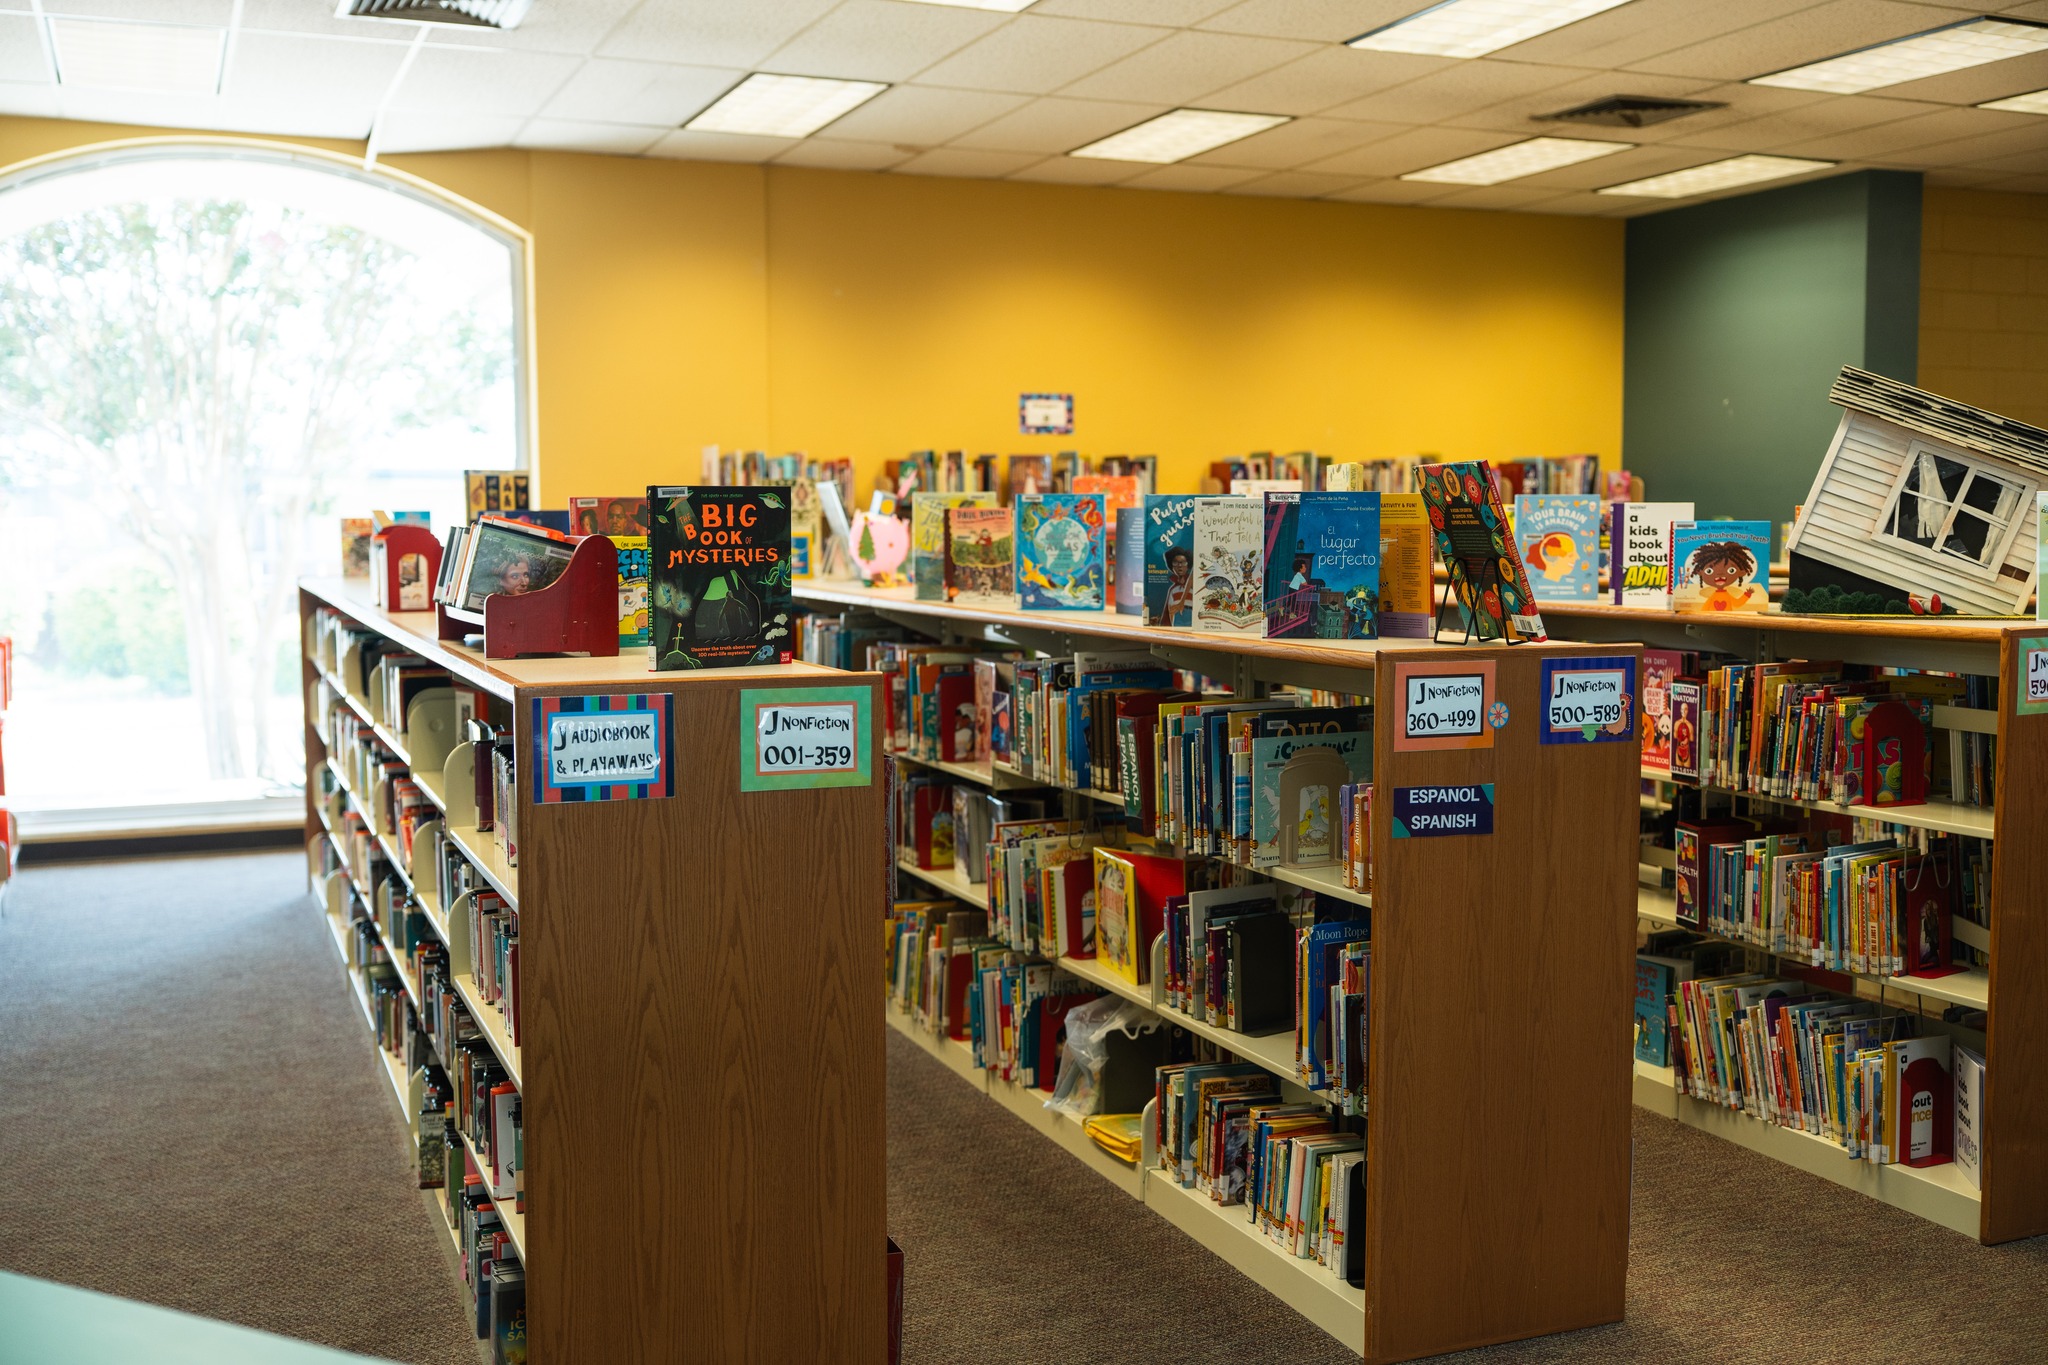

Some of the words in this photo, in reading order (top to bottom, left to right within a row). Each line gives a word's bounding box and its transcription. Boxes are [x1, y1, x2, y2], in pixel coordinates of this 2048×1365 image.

[679, 512, 691, 525] THE
[702, 503, 757, 528] BIG
[1150, 498, 1194, 525] Pulpo
[1528, 508, 1555, 524] YOUR
[1557, 508, 1587, 524] BRAIN
[1629, 515, 1638, 523] a
[1203, 512, 1253, 531] Wonderful
[1327, 525, 1335, 535] El
[1545, 518, 1580, 531] AMAZING
[1629, 525, 1658, 536] kids
[683, 523, 742, 546] BOOK
[745, 536, 752, 544] OF
[1208, 531, 1232, 544] That
[1321, 534, 1360, 553] lugar
[1708, 531, 1733, 539] Brushed
[1629, 539, 1663, 549] book
[667, 547, 779, 569] MYSTERIES
[1318, 550, 1376, 569] perfecto
[1629, 553, 1668, 563] about
[2031, 653, 2039, 673] J
[1415, 682, 1426, 705] J
[1554, 677, 1565, 699] J
[1673, 685, 1695, 695] HUMAN
[2031, 679, 2048, 696] 59
[1672, 694, 1699, 704] ANATOMY
[764, 710, 778, 735] J
[1409, 709, 1476, 732] 360-499
[1551, 704, 1621, 724] 500-589
[554, 725, 567, 751] J
[571, 724, 650, 744] AUDIOBOOK
[556, 759, 567, 774] &
[572, 753, 654, 774] PLAYAWAYS
[764, 745, 851, 767] 001-359
[1120, 734, 1130, 801] SPANISH
[1128, 733, 1139, 806] ESPANOL
[1409, 787, 1480, 804] ESPANOL
[1411, 813, 1477, 830] SPANISH
[1677, 864, 1698, 878] HEALTH
[1315, 929, 1341, 940] Moon
[1344, 926, 1368, 938] Rope
[1900, 1055, 1908, 1063] a
